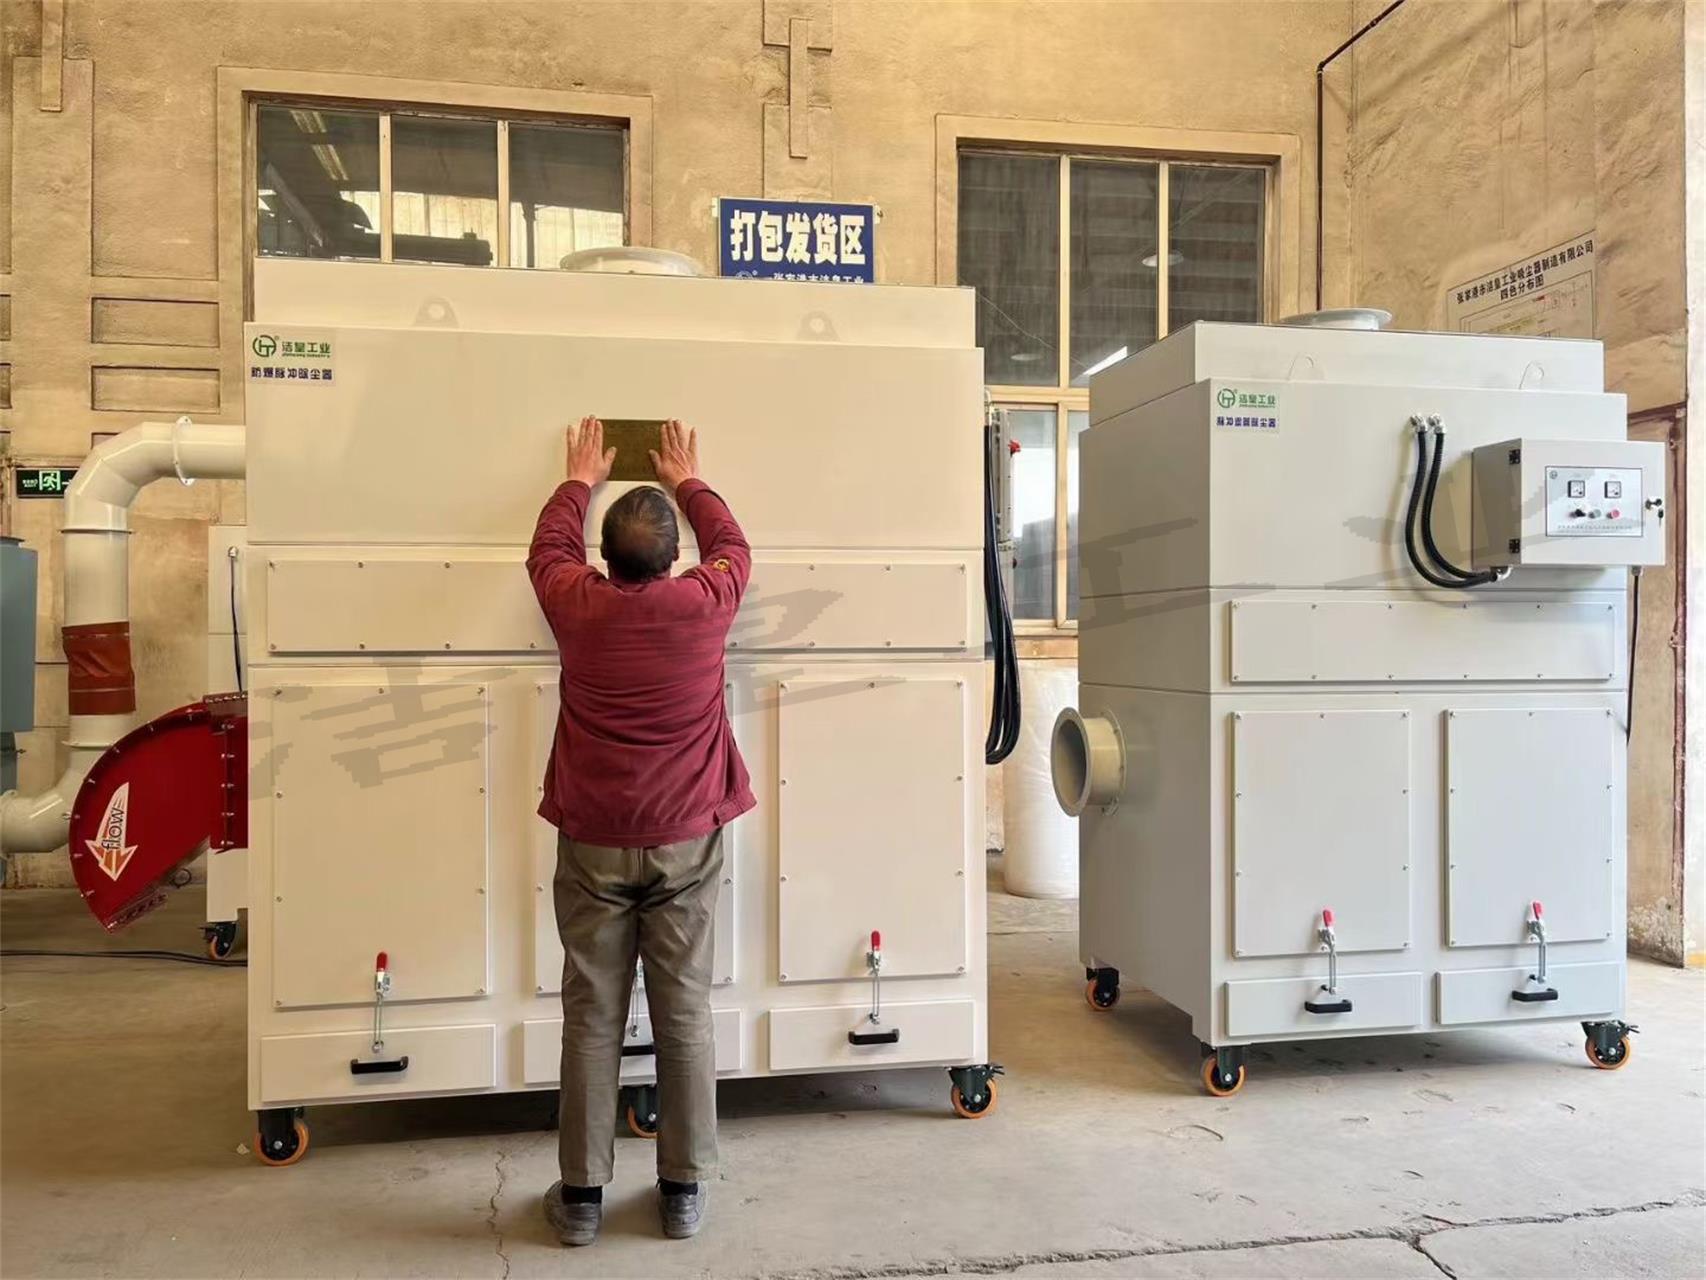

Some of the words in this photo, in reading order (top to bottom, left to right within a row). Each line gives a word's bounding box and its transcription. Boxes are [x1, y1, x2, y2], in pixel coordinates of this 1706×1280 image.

[730, 209, 866, 265] 打包发货区
[1500, 274, 1545, 300] 四色分布图
[101, 807, 124, 851] flow
